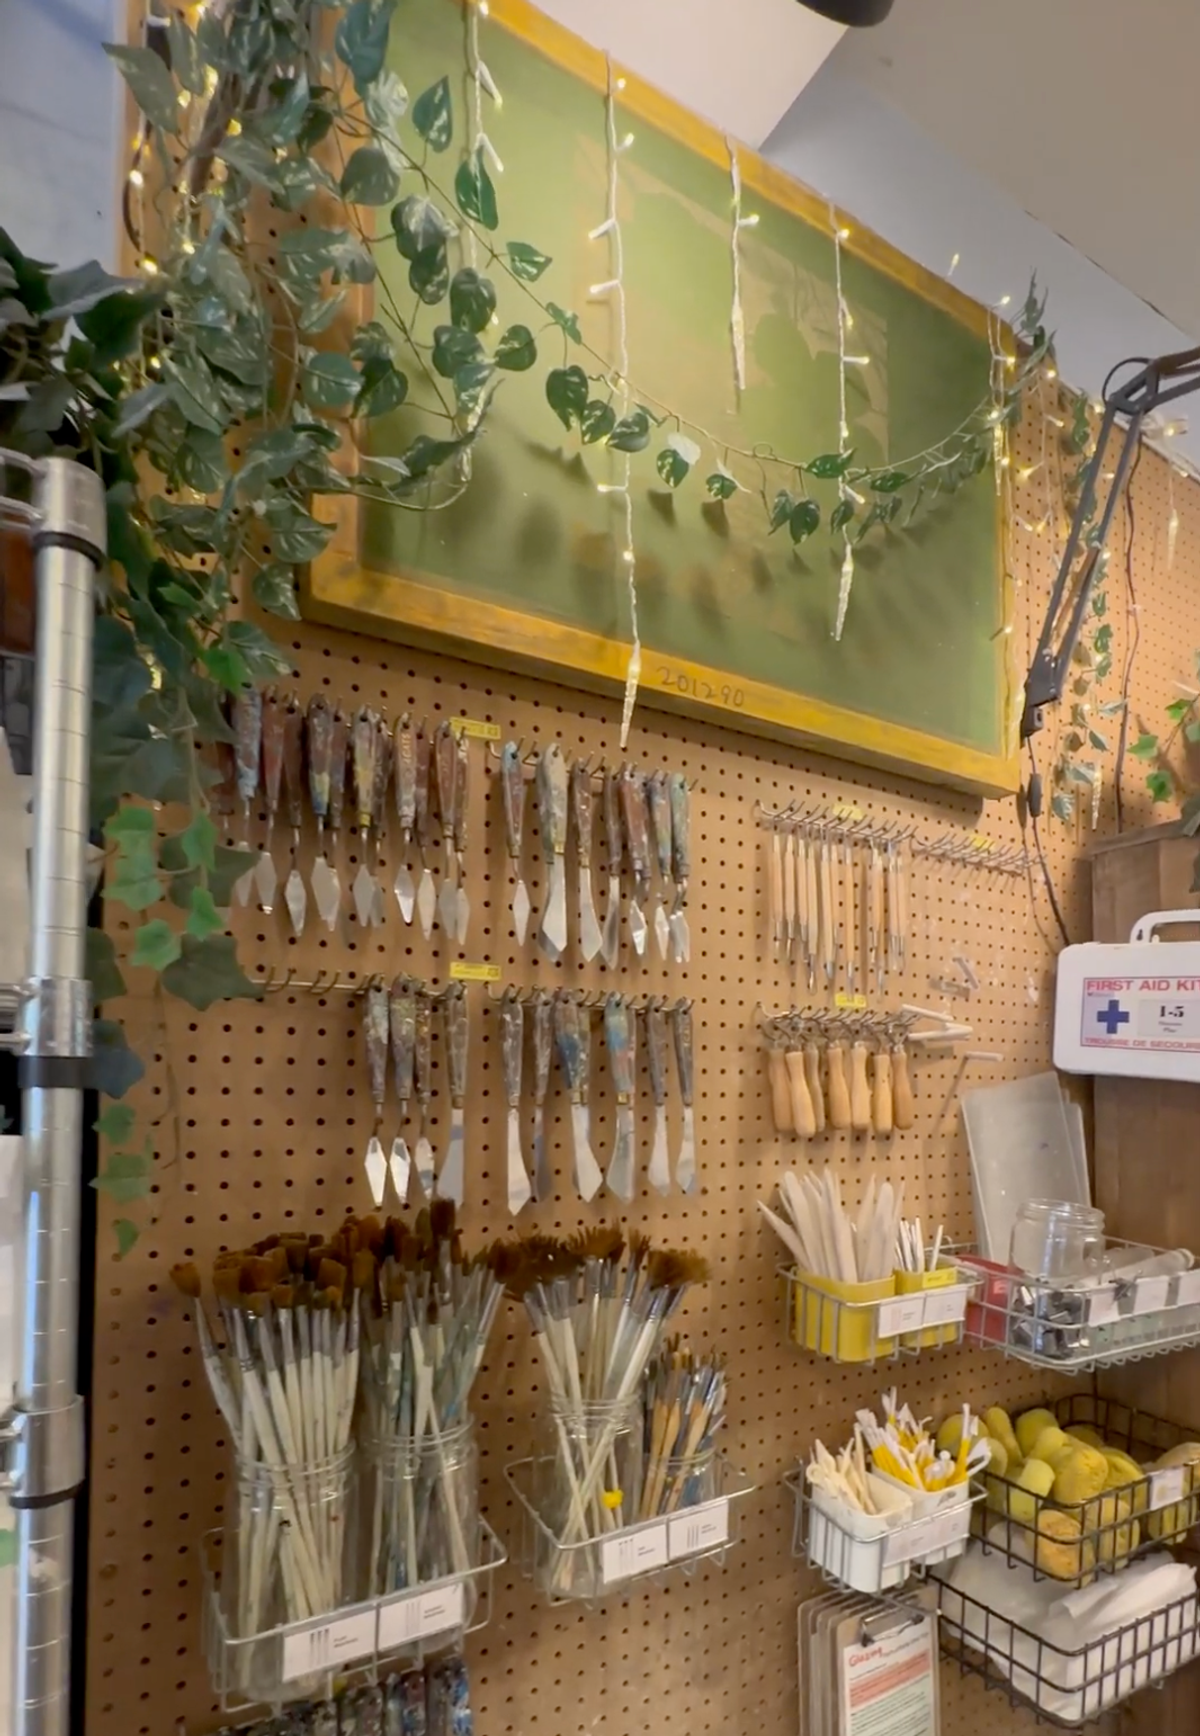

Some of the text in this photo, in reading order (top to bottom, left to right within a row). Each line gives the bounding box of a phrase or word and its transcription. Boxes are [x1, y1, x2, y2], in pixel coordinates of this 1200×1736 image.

[656, 666, 744, 707] 201290
[1086, 980, 1133, 991] FIRST
[1139, 980, 1170, 991] AID
[1133, 1039, 1146, 1047] DE
